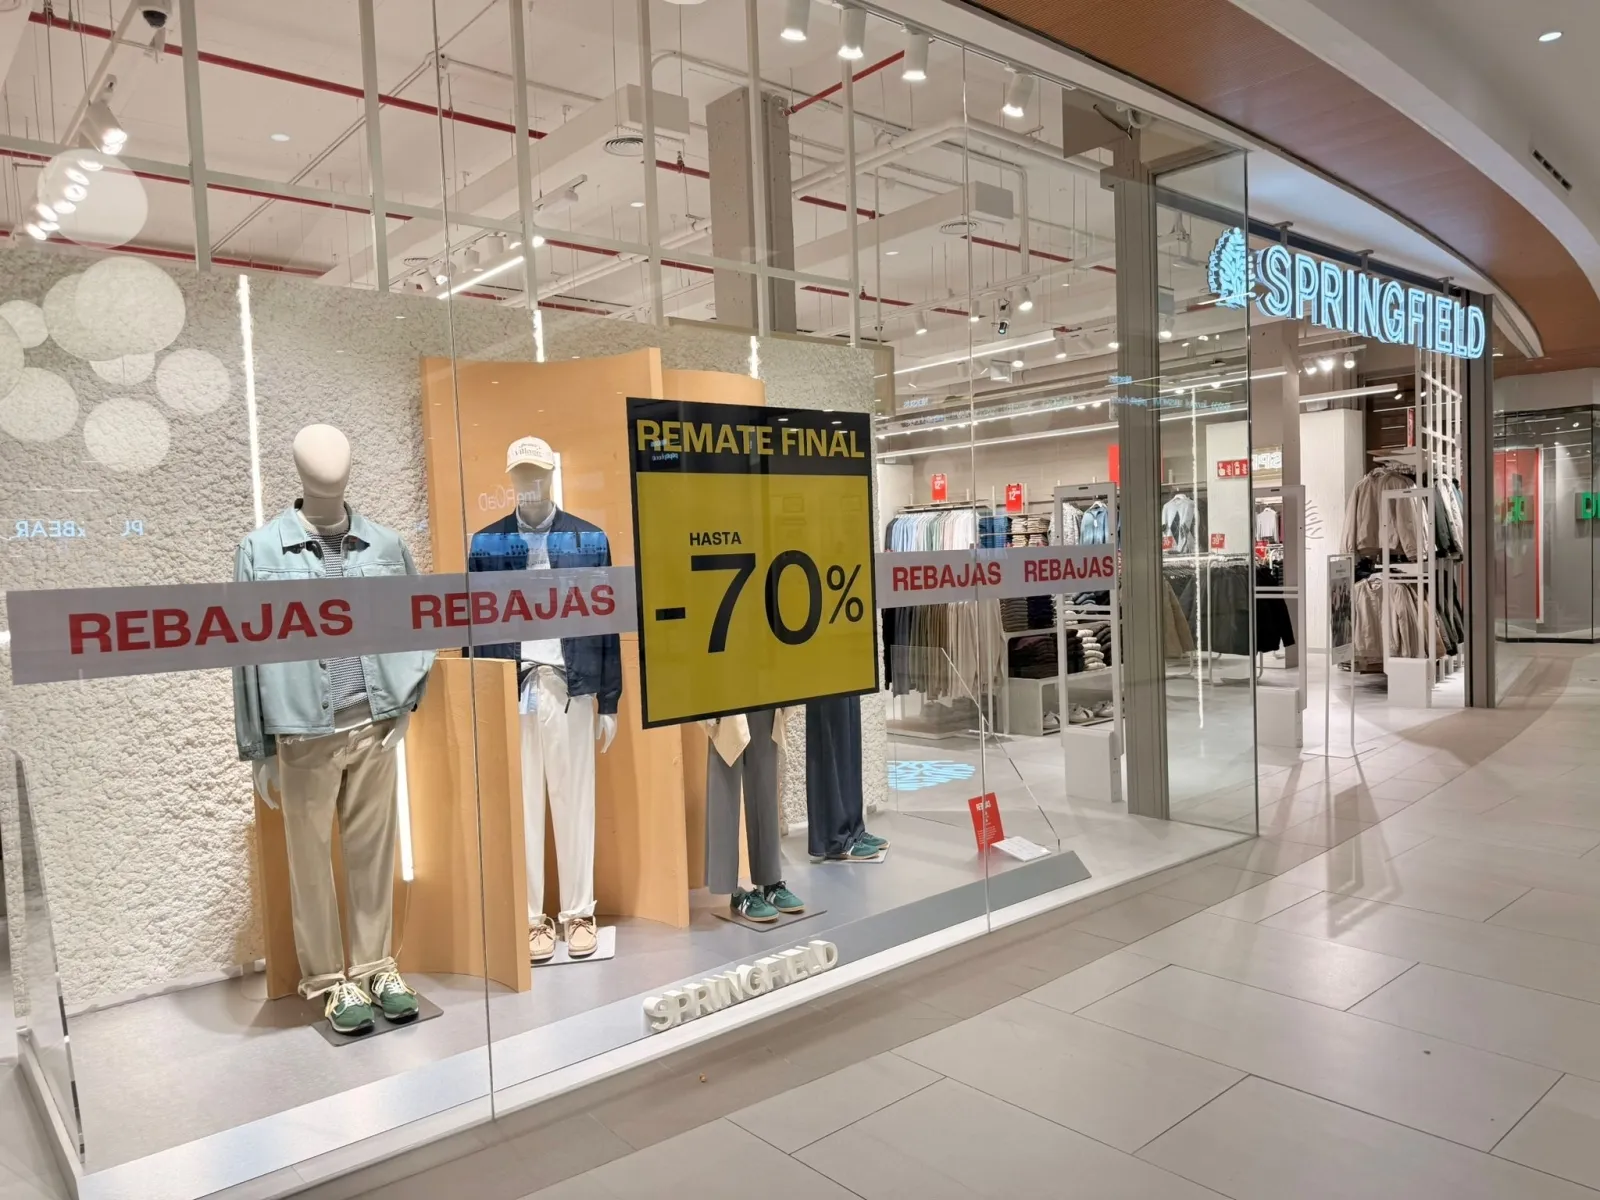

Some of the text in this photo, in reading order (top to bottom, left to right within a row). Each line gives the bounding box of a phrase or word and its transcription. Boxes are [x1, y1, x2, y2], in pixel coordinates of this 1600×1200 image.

[1255, 245, 1486, 360] SPRINGFIELD
[636, 419, 865, 458] REMATE FINAL
[689, 531, 742, 546] HASTA
[892, 555, 1114, 592] REBAJAS REBAJAS
[69, 583, 615, 655] REBAJAS REBAJAS
[655, 549, 864, 654] -70%
[642, 940, 838, 1033] SPRINGFIELD
